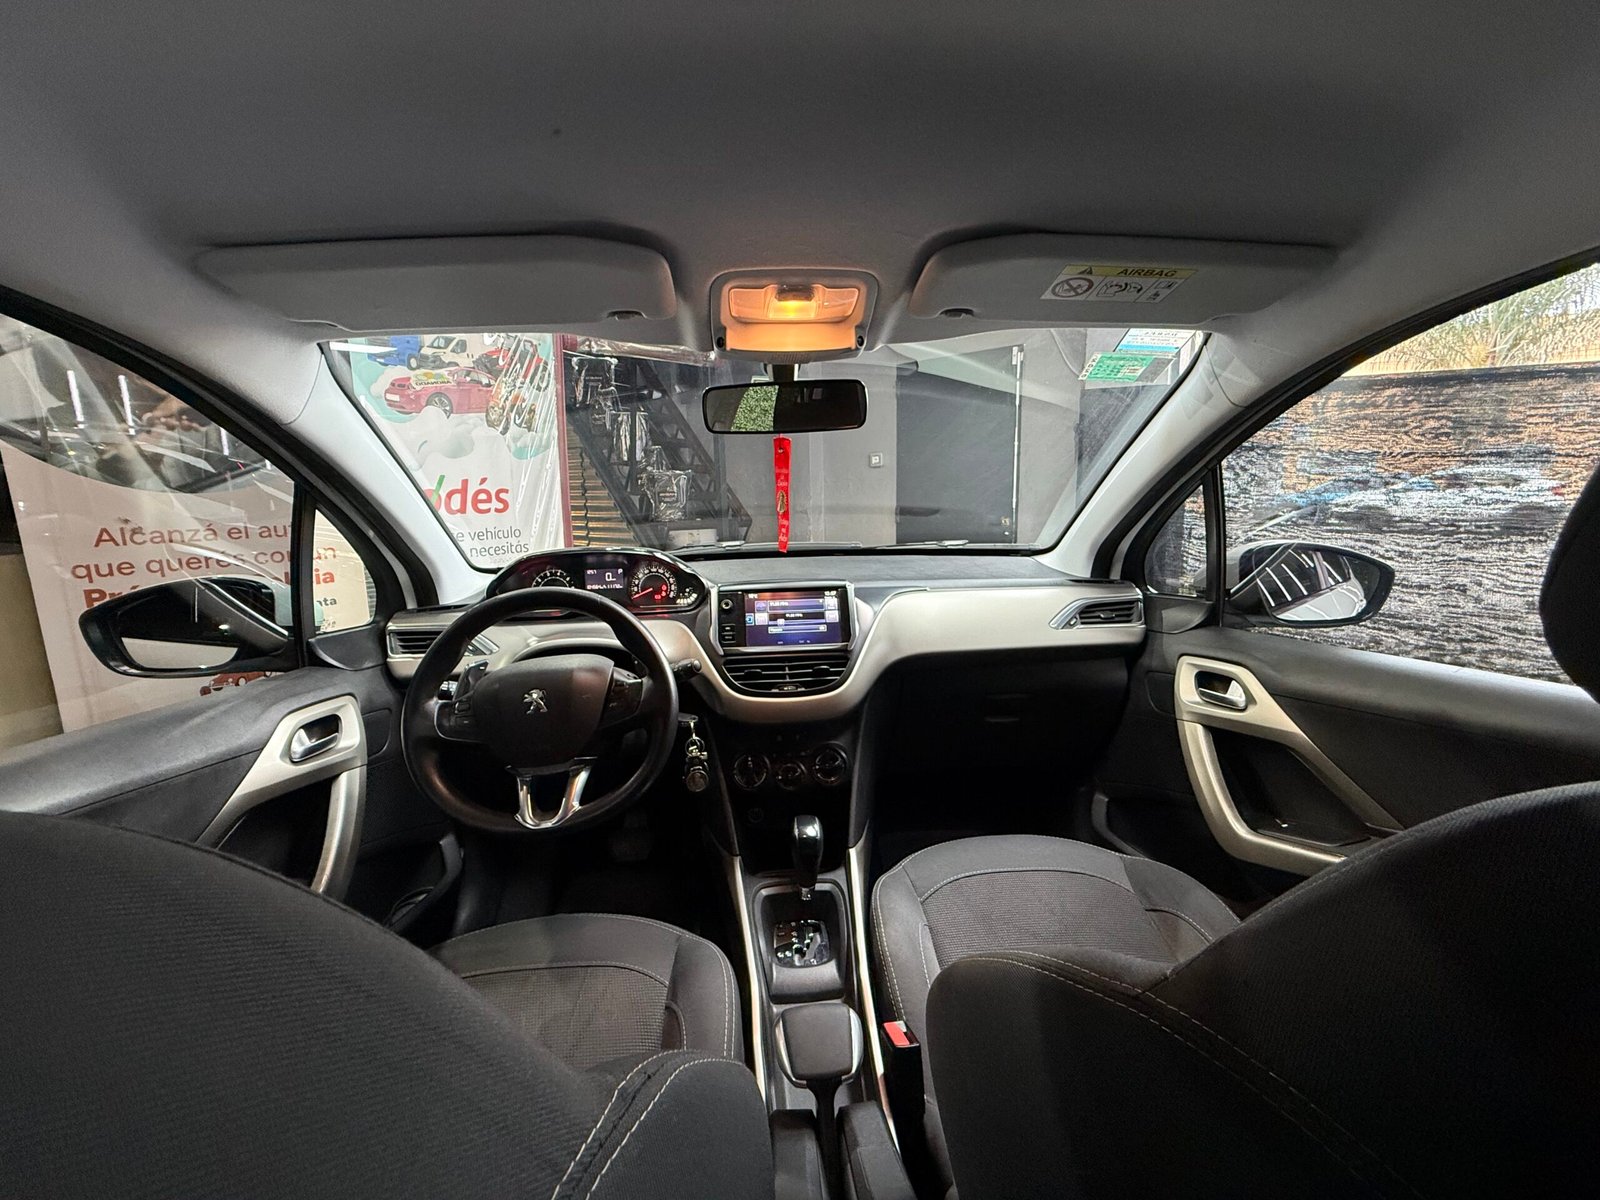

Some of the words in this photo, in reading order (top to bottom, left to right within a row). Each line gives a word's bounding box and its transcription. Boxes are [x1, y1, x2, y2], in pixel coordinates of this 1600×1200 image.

[1117, 268, 1177, 277] AIRBAG
[94, 523, 218, 548] Alcanzá
[227, 522, 250, 540] el
[258, 524, 292, 539] au
[468, 526, 522, 541] vehículo
[470, 540, 529, 557] necesitás
[71, 561, 135, 583] que
